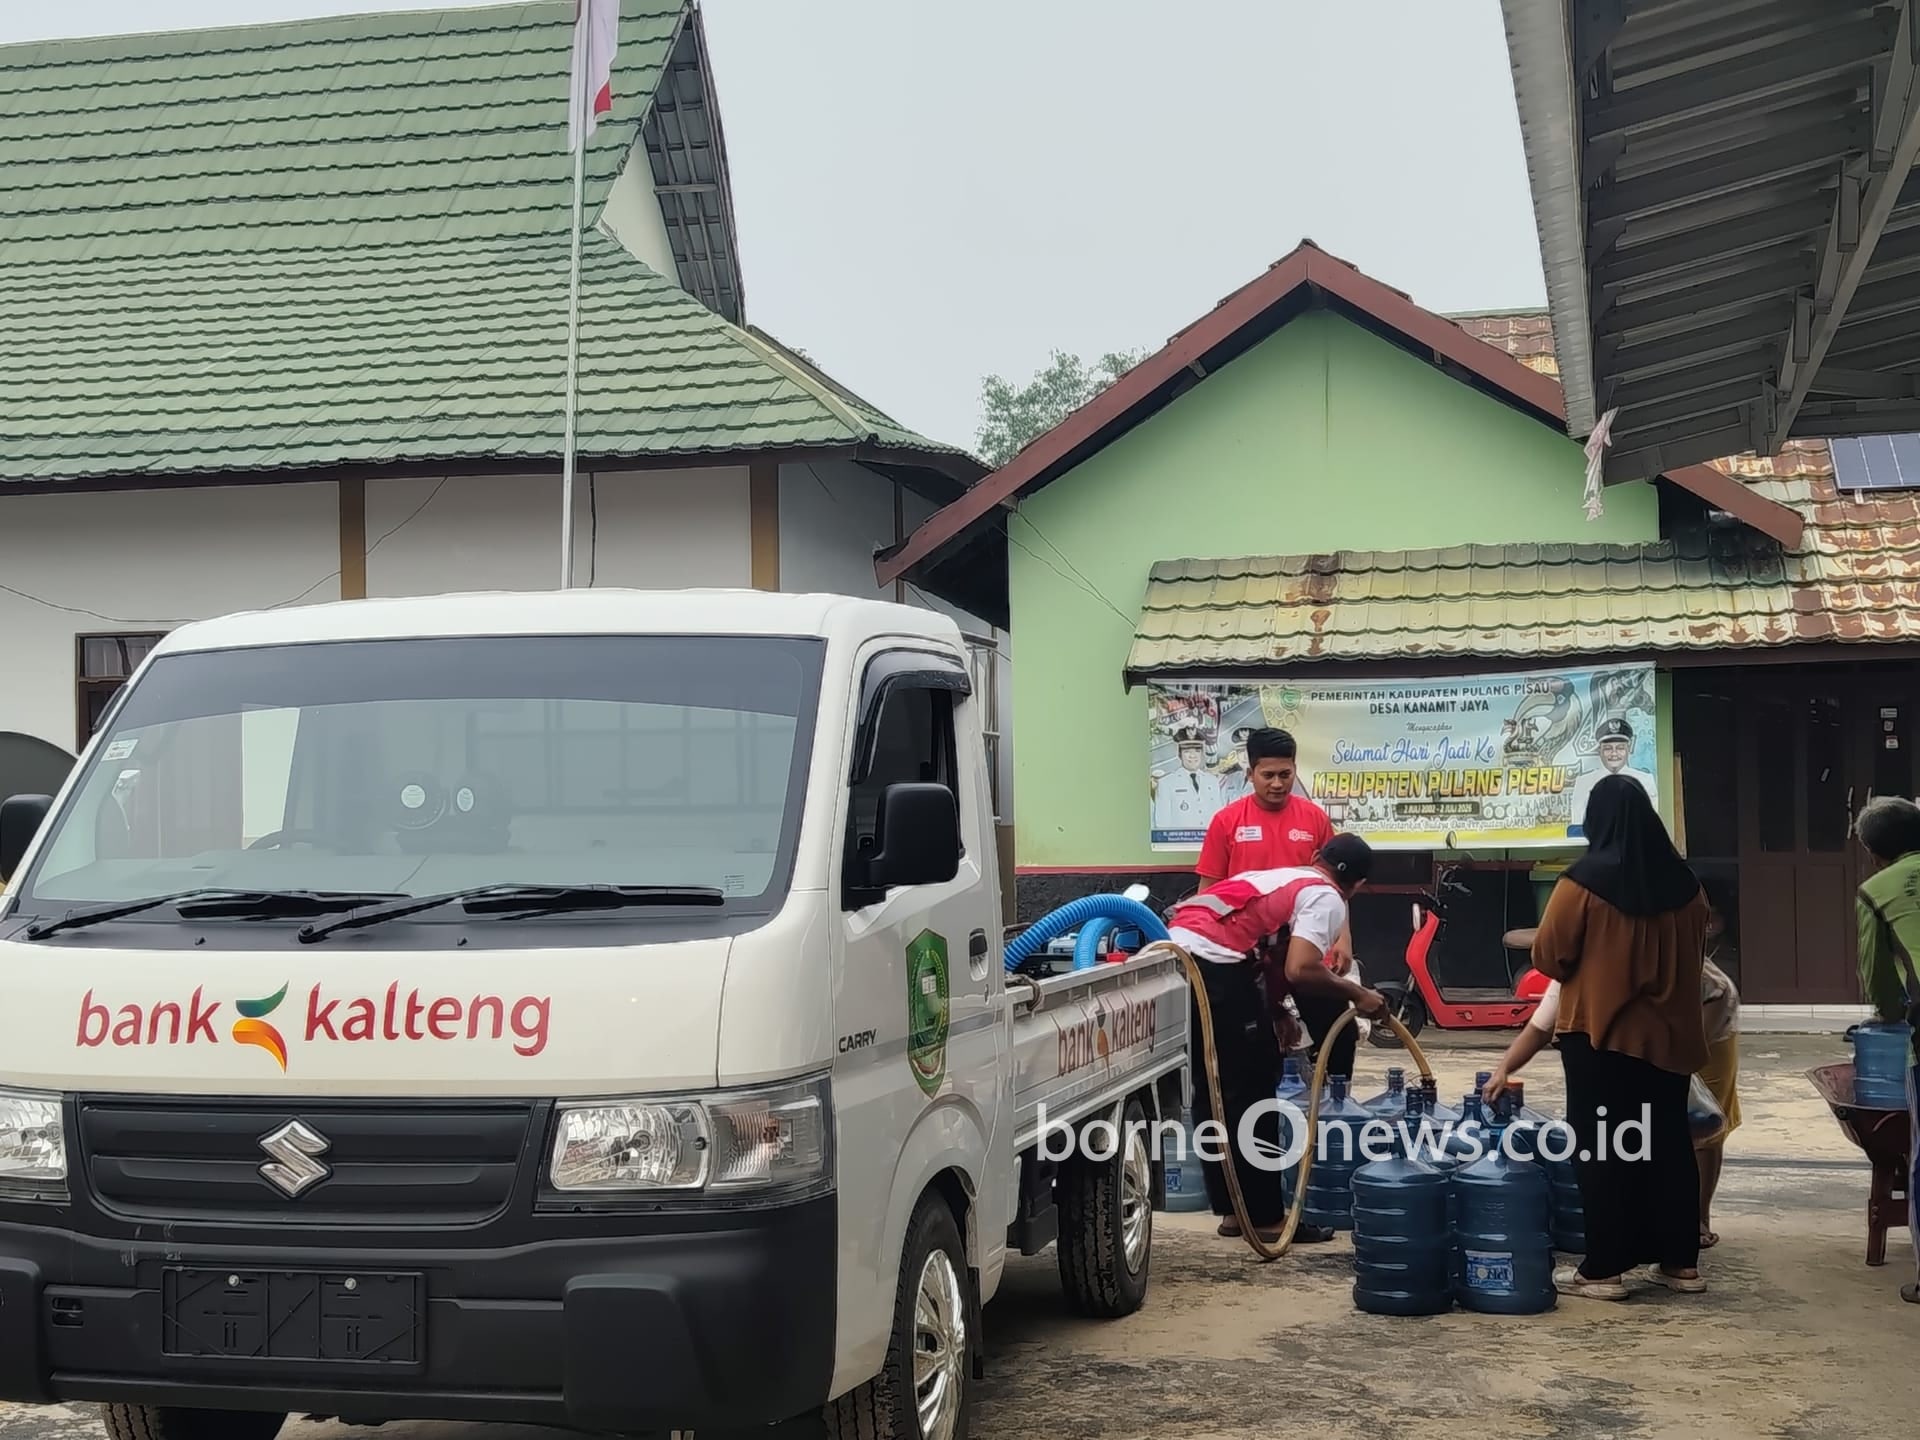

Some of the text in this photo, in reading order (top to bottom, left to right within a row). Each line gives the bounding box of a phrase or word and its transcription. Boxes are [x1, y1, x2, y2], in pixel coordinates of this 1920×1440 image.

[1311, 682, 1550, 701] PEMERINTAH KABUPATEN PULANG PISAU
[1370, 700, 1490, 715] DESA KANAMIT JAYA
[1332, 739, 1391, 765] Selamat
[1391, 737, 1430, 763] Hari
[1433, 736, 1472, 770] Jadi
[1474, 735, 1496, 763] Ke
[1312, 766, 1566, 799] KABUPATEN PULANG PISAU
[76, 978, 552, 1057] bank kalteng
[838, 1028, 877, 1054] CARRY
[1056, 998, 1157, 1079] bank kalteng
